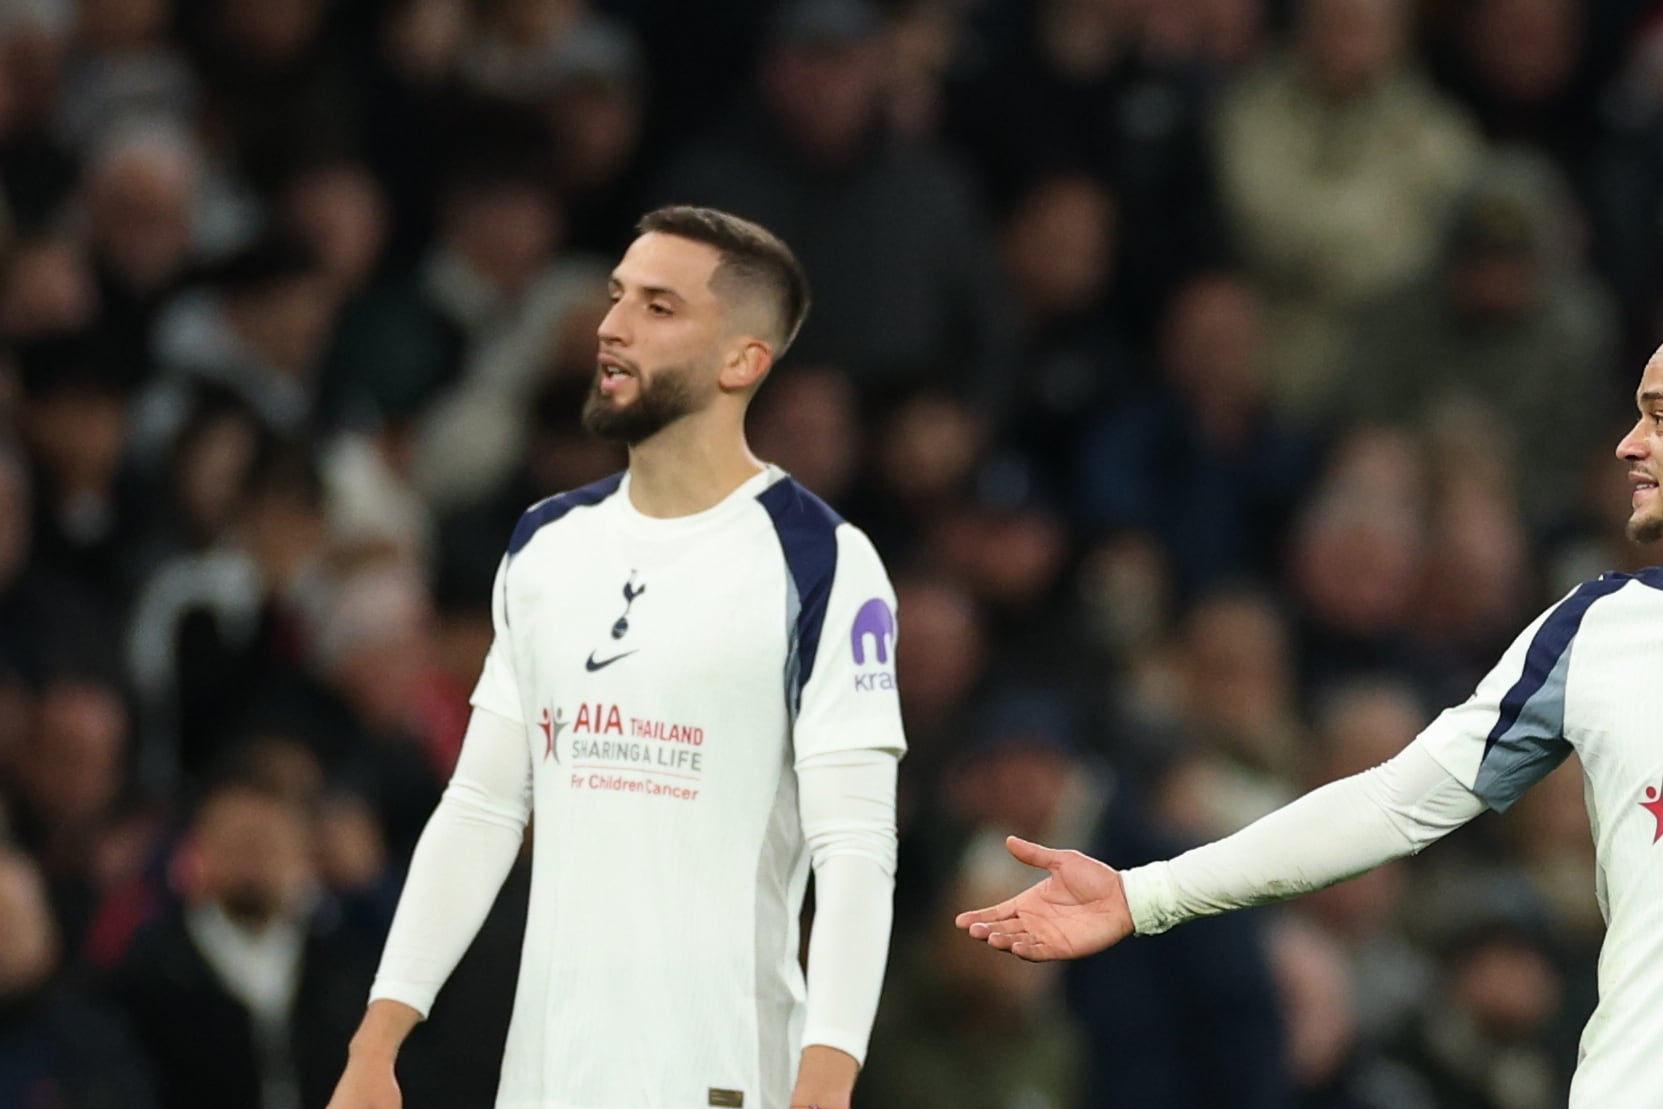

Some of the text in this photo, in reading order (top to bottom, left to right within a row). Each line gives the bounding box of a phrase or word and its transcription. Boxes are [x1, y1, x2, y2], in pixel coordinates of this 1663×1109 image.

[855, 671, 896, 691] kra
[573, 702, 704, 746] AIA THAILAND
[571, 739, 703, 772] SHARING A LIFE
[571, 774, 700, 801] Fr Children Cancer
